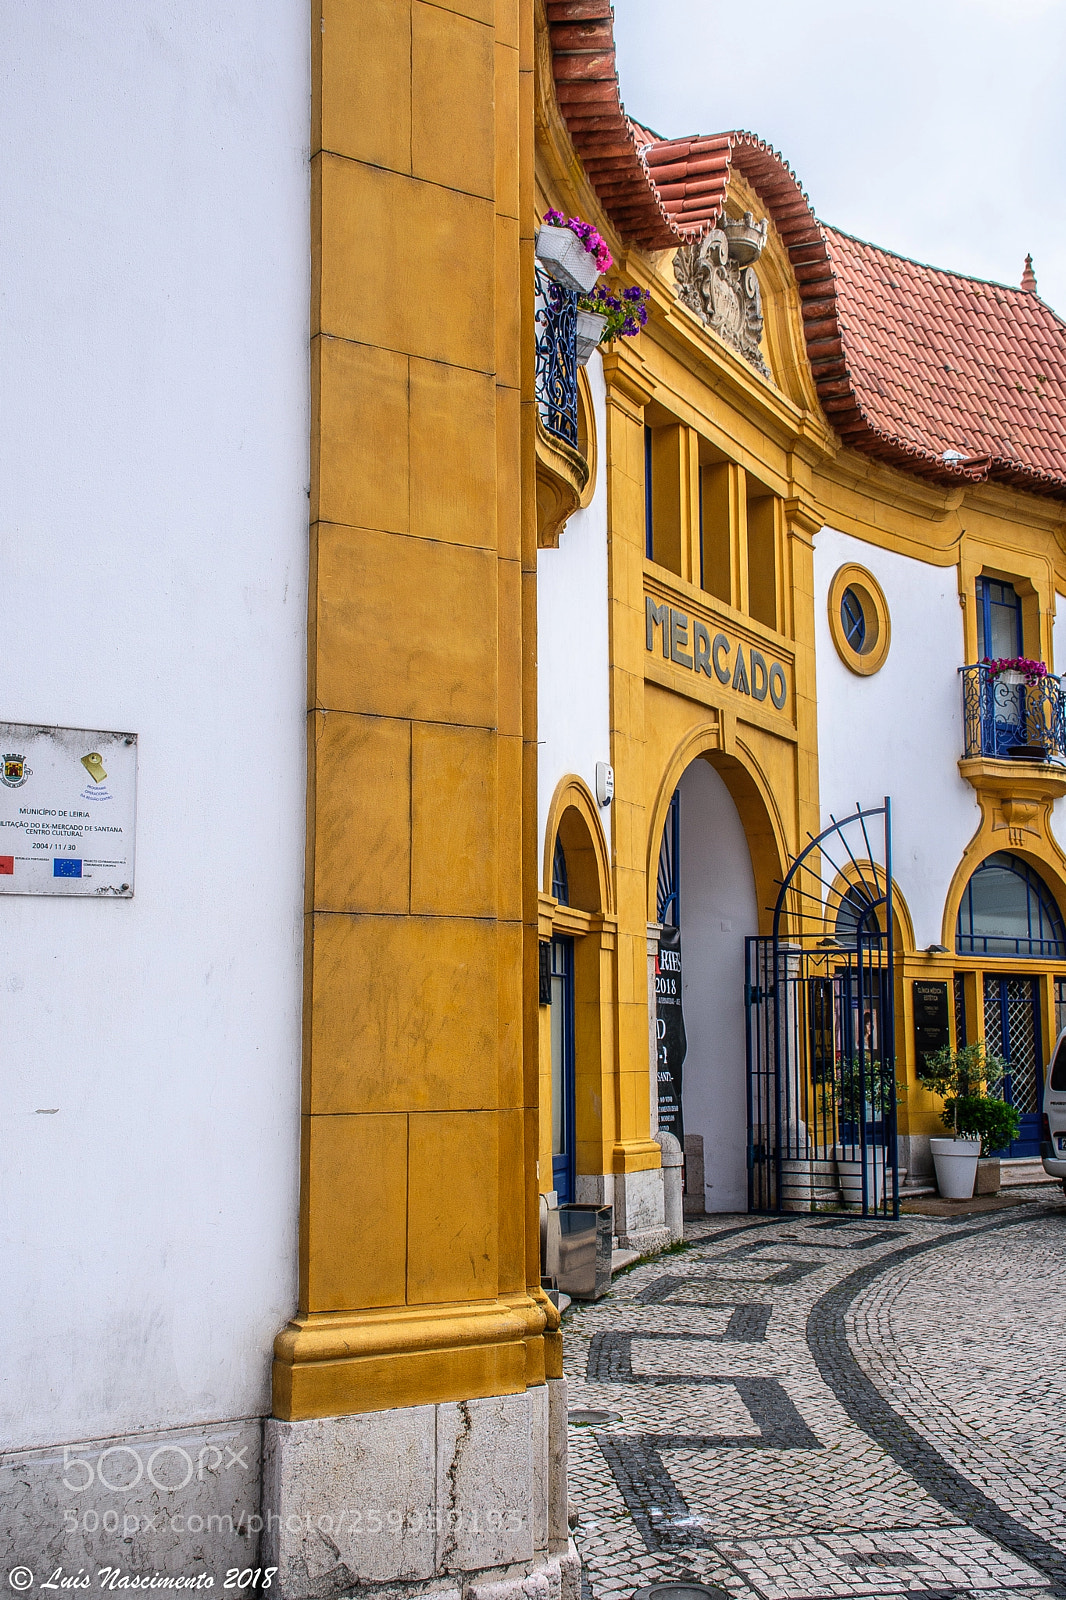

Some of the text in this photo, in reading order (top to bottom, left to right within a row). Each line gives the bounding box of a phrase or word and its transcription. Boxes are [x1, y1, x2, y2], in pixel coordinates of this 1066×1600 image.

[645, 595, 787, 711] MERCADO
[19, 808, 57, 816] MUNICÍPIO
[42, 823, 83, 831] EX-MERCADO
[655, 977, 677, 995] 2018
